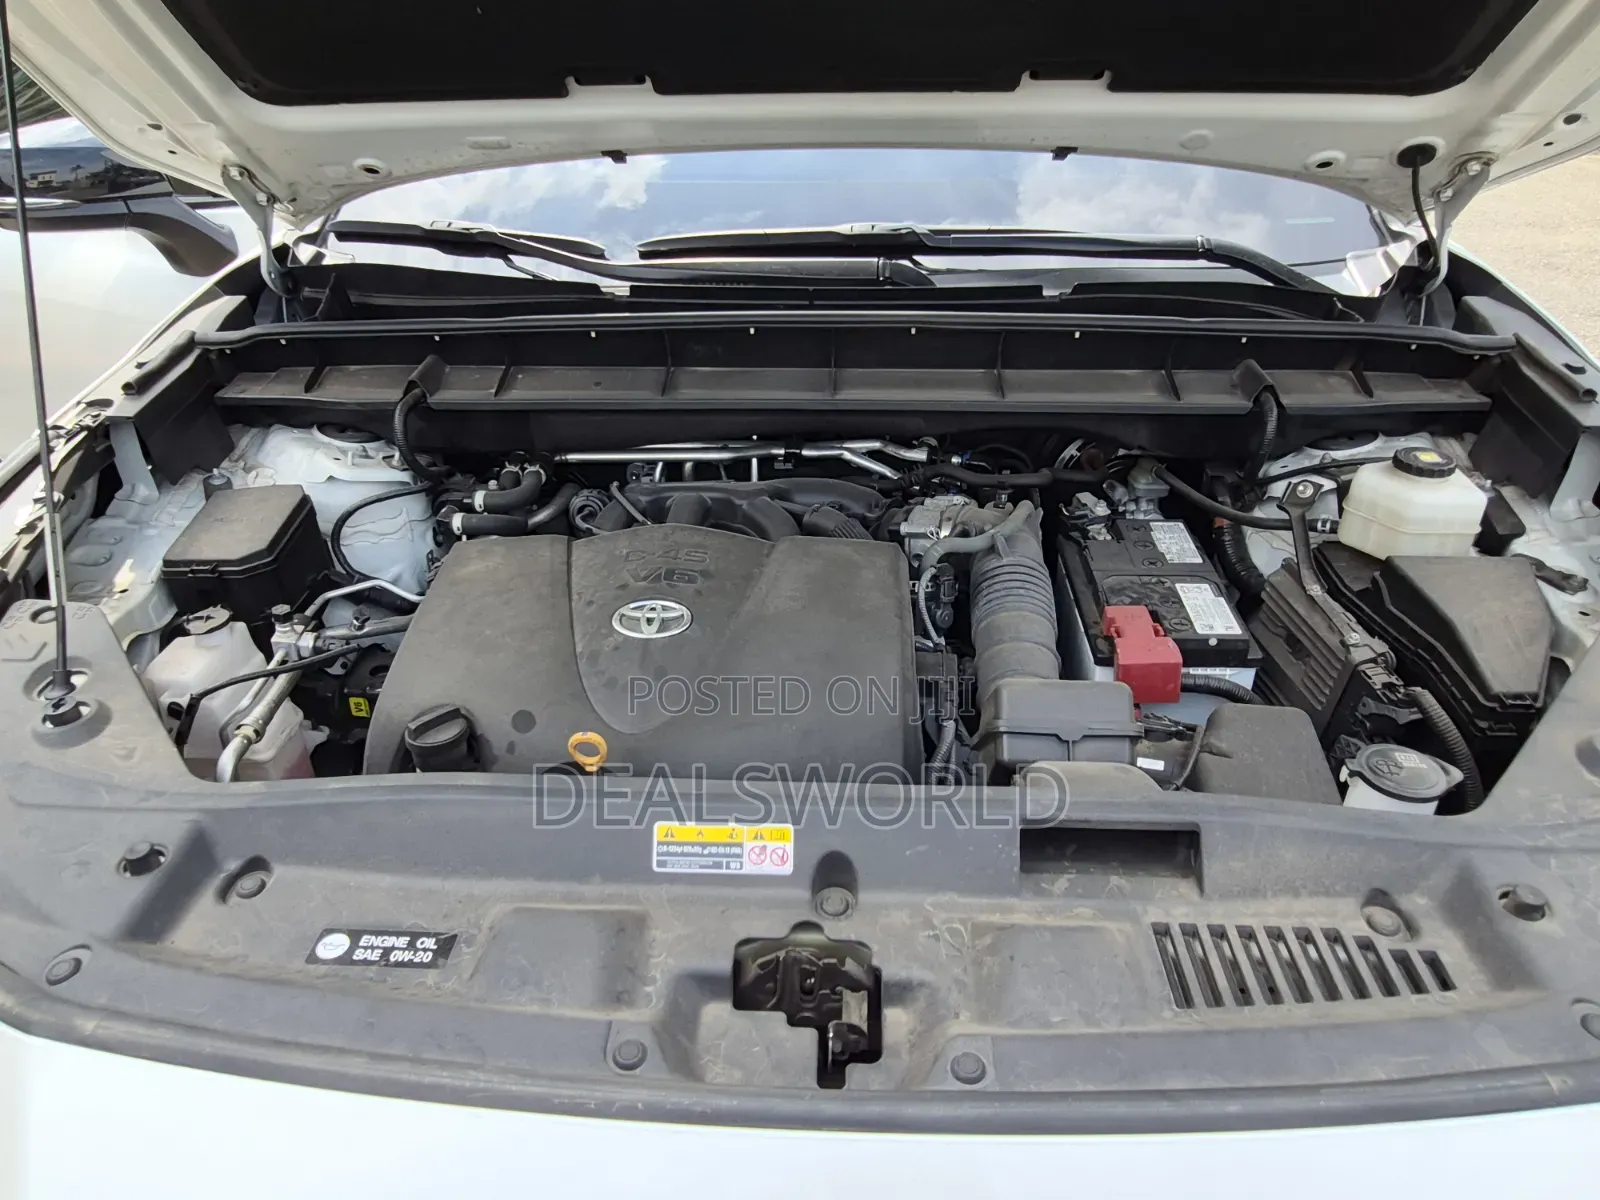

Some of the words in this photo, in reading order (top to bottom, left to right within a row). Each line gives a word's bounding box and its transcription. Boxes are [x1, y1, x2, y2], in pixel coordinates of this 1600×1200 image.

[625, 565, 700, 585] V6
[358, 934, 411, 949] ENGINE
[415, 936, 438, 949] OIL
[352, 948, 382, 961] SAE
[388, 950, 433, 963] 0W-20
